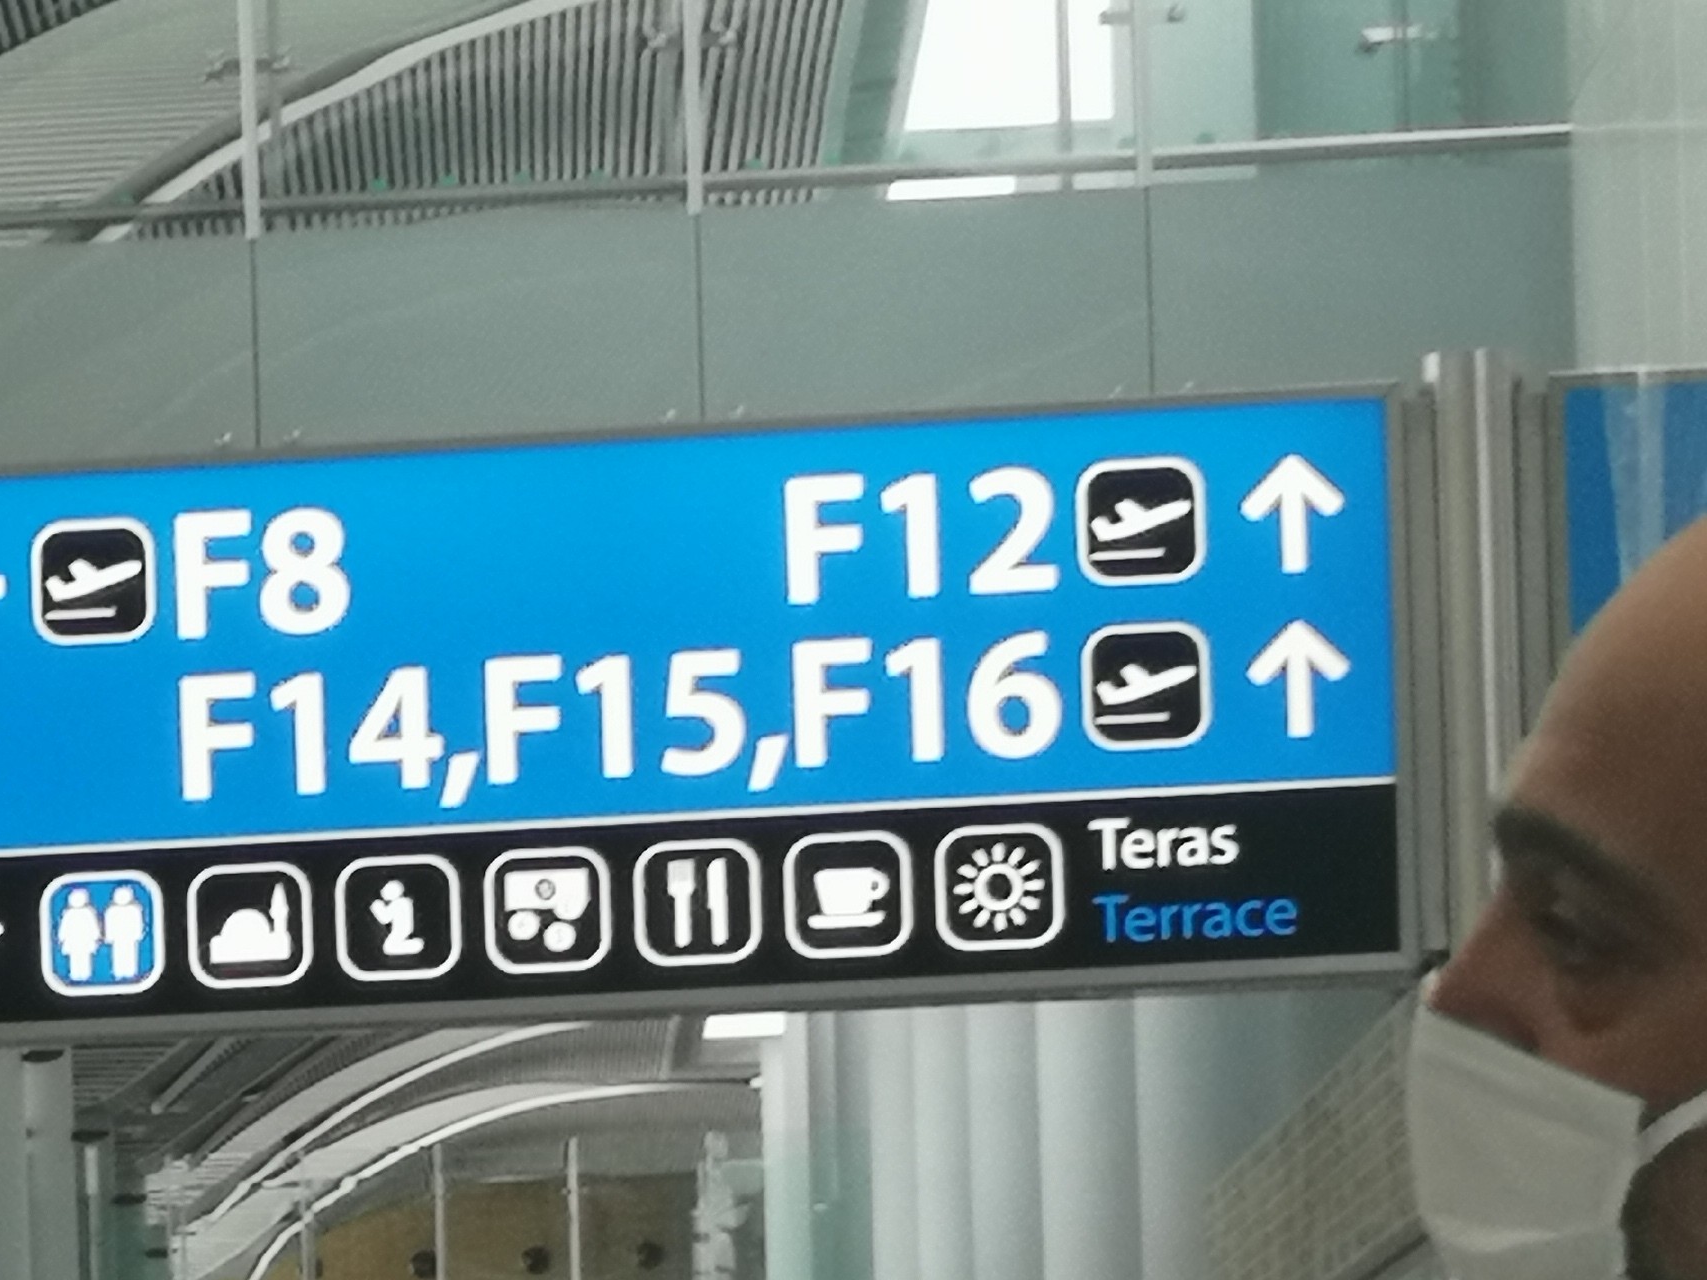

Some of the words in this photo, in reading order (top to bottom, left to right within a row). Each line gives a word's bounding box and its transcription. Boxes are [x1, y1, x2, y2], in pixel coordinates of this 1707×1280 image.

[173, 507, 351, 639] F8
[784, 466, 1059, 605] F12
[179, 630, 1063, 808] F14,F15,F16
[1087, 817, 1240, 871] Teras
[1092, 893, 1298, 943] Terrace
